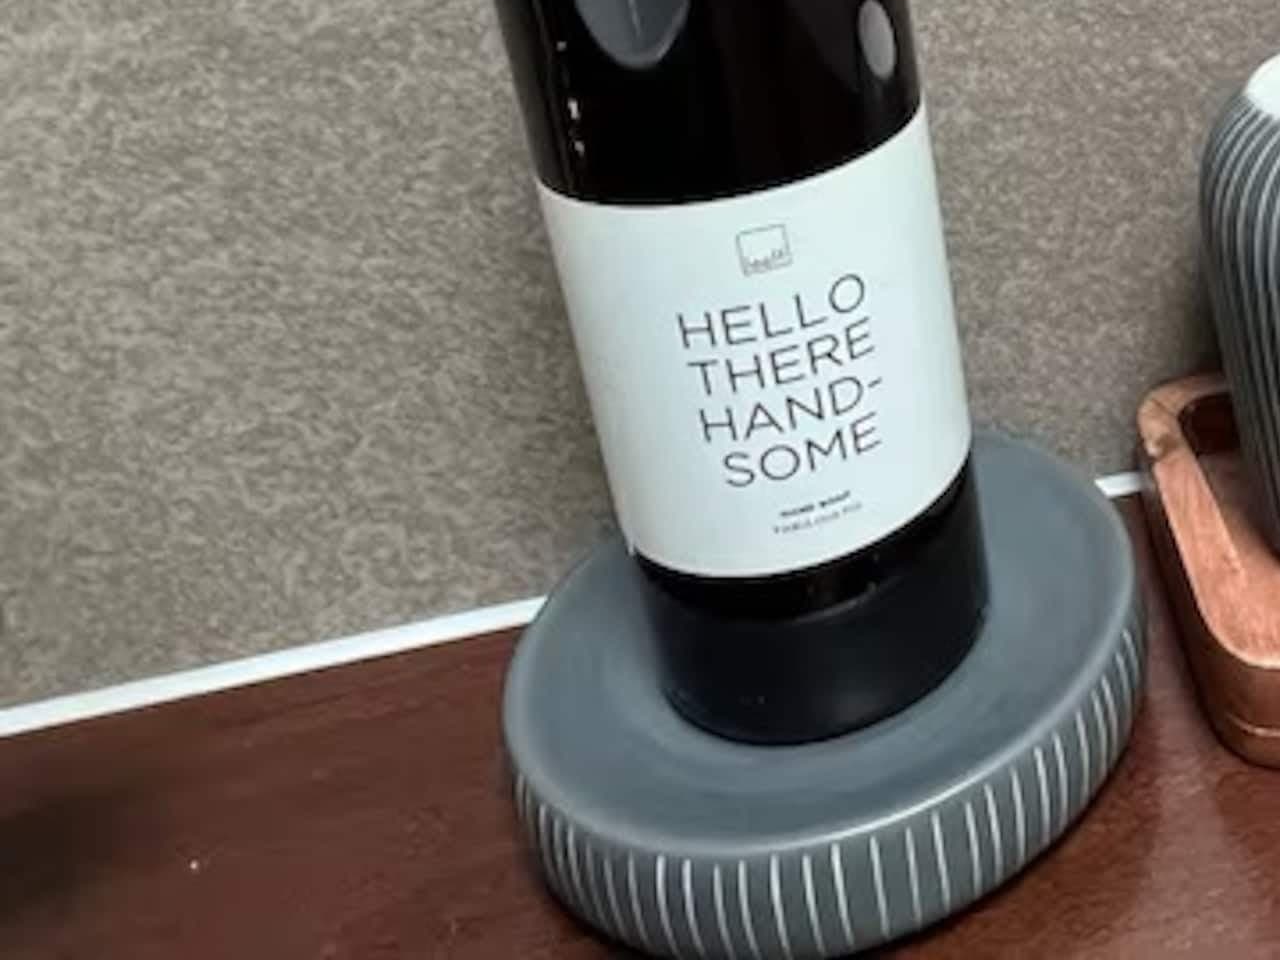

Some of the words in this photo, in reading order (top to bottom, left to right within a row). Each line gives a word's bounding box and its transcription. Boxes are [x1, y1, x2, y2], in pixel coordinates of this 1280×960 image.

[677, 274, 865, 349] HELLO
[686, 316, 875, 396] THERE
[699, 377, 883, 443] HAND-
[722, 411, 882, 488] SOME
